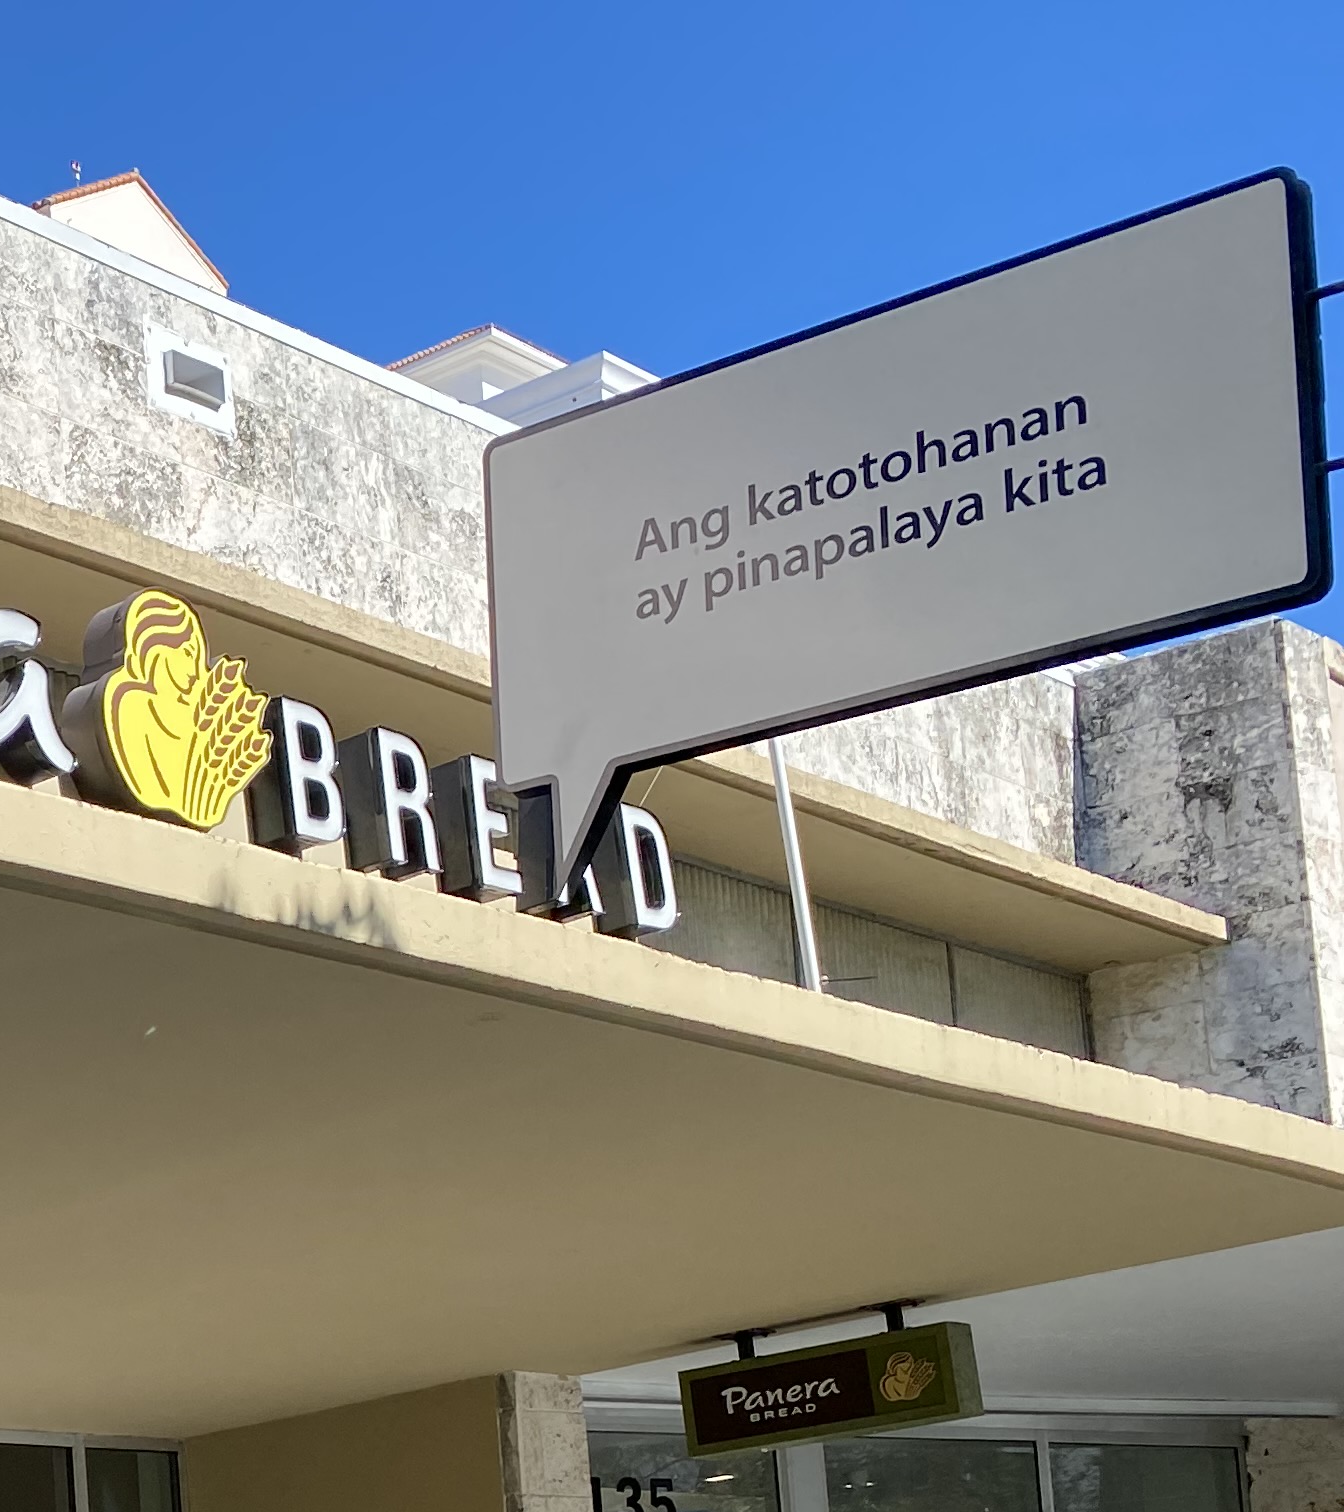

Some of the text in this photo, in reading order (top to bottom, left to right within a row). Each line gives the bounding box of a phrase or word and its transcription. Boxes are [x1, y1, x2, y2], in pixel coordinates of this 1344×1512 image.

[633, 393, 1089, 561] Ang katotohanan
[635, 454, 1109, 626] ay pinapalaya kita
[280, 695, 681, 931] BRED
[720, 1377, 841, 1415] Panera
[749, 1403, 817, 1423] BREAD
